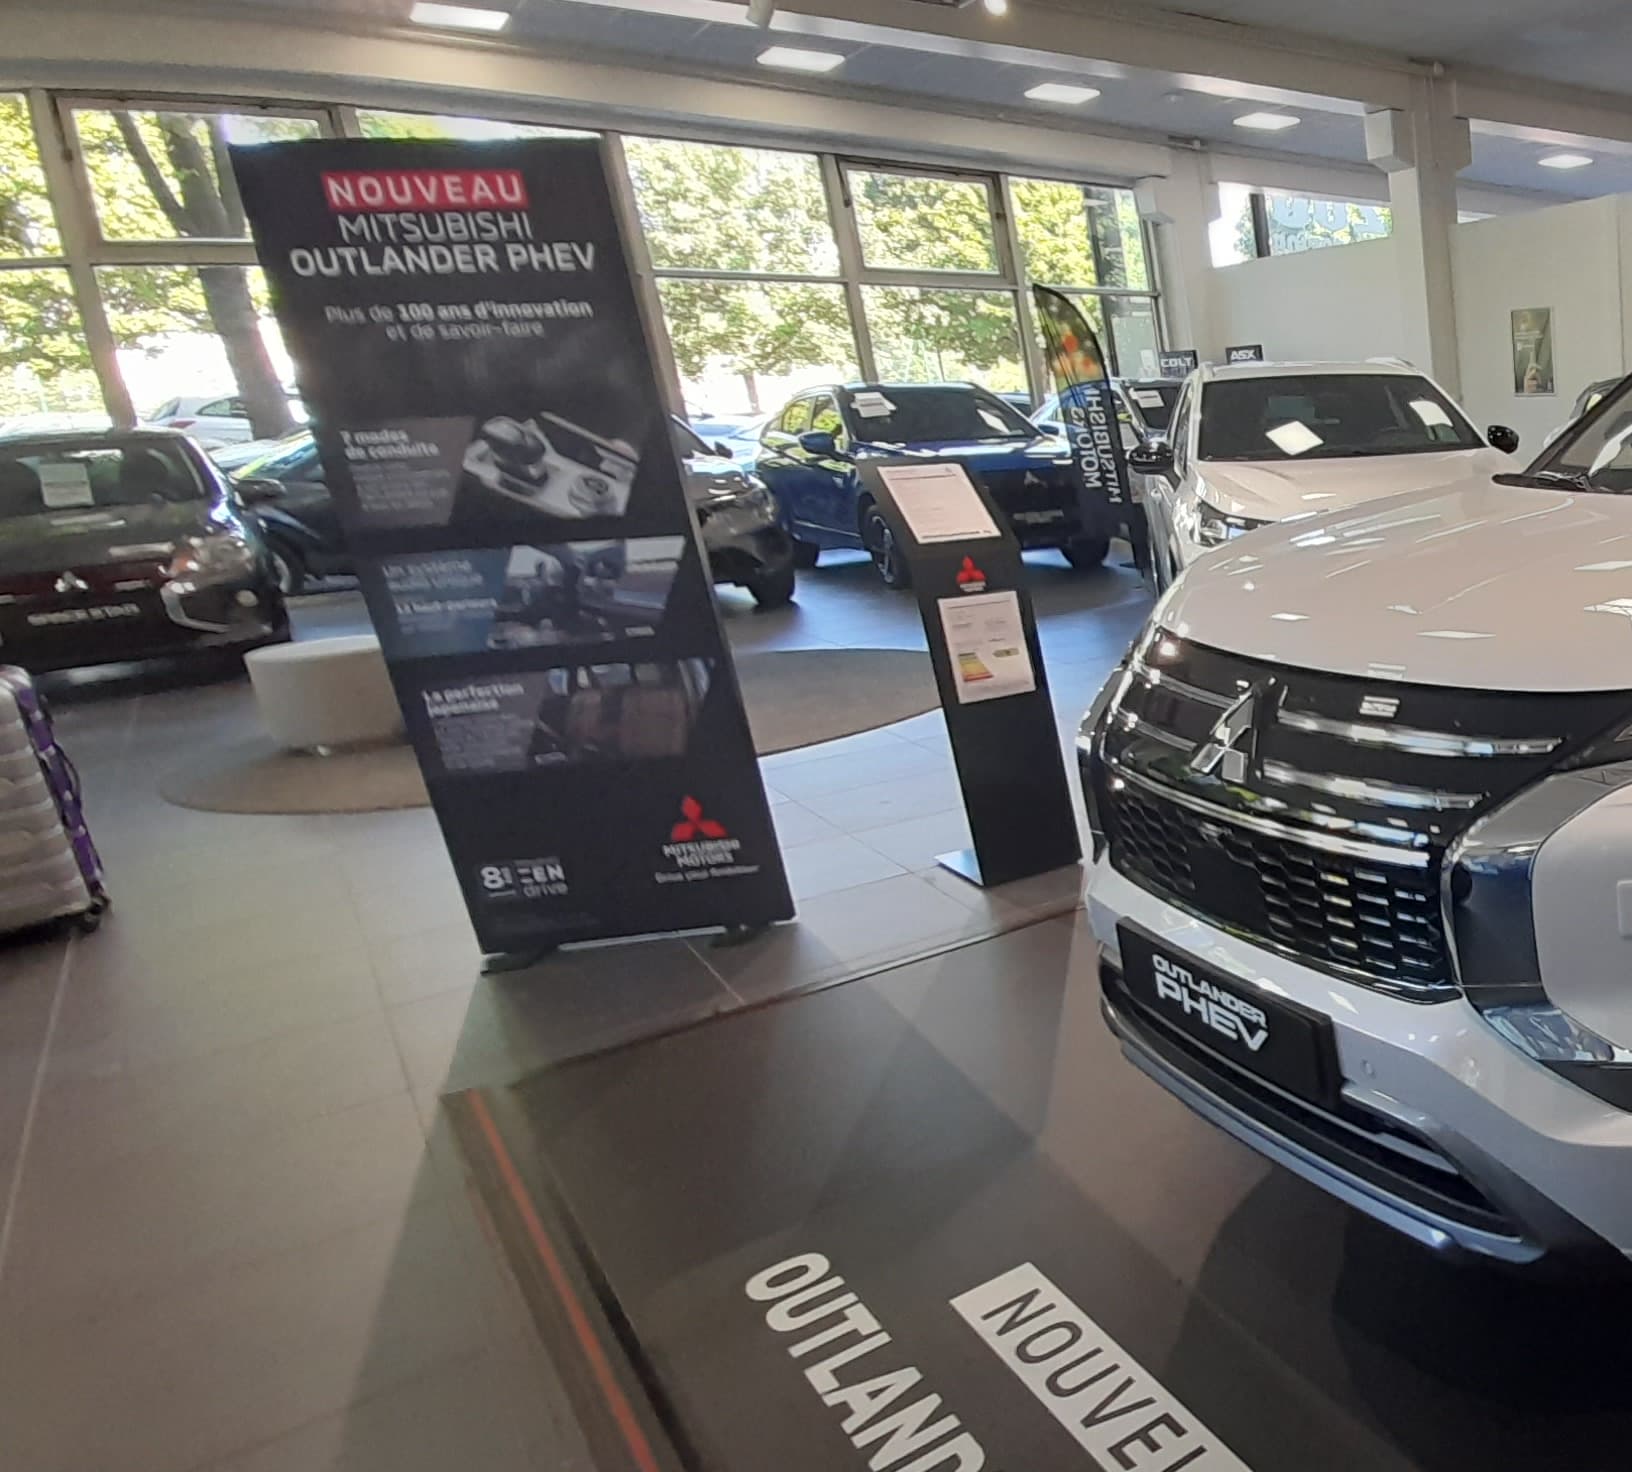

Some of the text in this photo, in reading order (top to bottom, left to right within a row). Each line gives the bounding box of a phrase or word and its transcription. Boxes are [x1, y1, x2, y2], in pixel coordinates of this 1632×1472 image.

[326, 174, 522, 206] NOUVEAU
[337, 211, 533, 244] MITSUBISHI
[290, 242, 596, 277] OUTLANDER PHEV
[325, 306, 366, 324] Plus
[370, 303, 394, 323] de
[397, 302, 434, 322] 100
[437, 304, 472, 321] ans
[386, 318, 545, 341] et de savoir-faire
[1160, 357, 1193, 368] COLT
[1230, 349, 1257, 360] ASX
[662, 839, 740, 857] MITSUBISHI
[676, 852, 734, 868] MOTORS
[1152, 953, 1268, 1029] OUTLANDER
[1154, 972, 1269, 1051] PHEV
